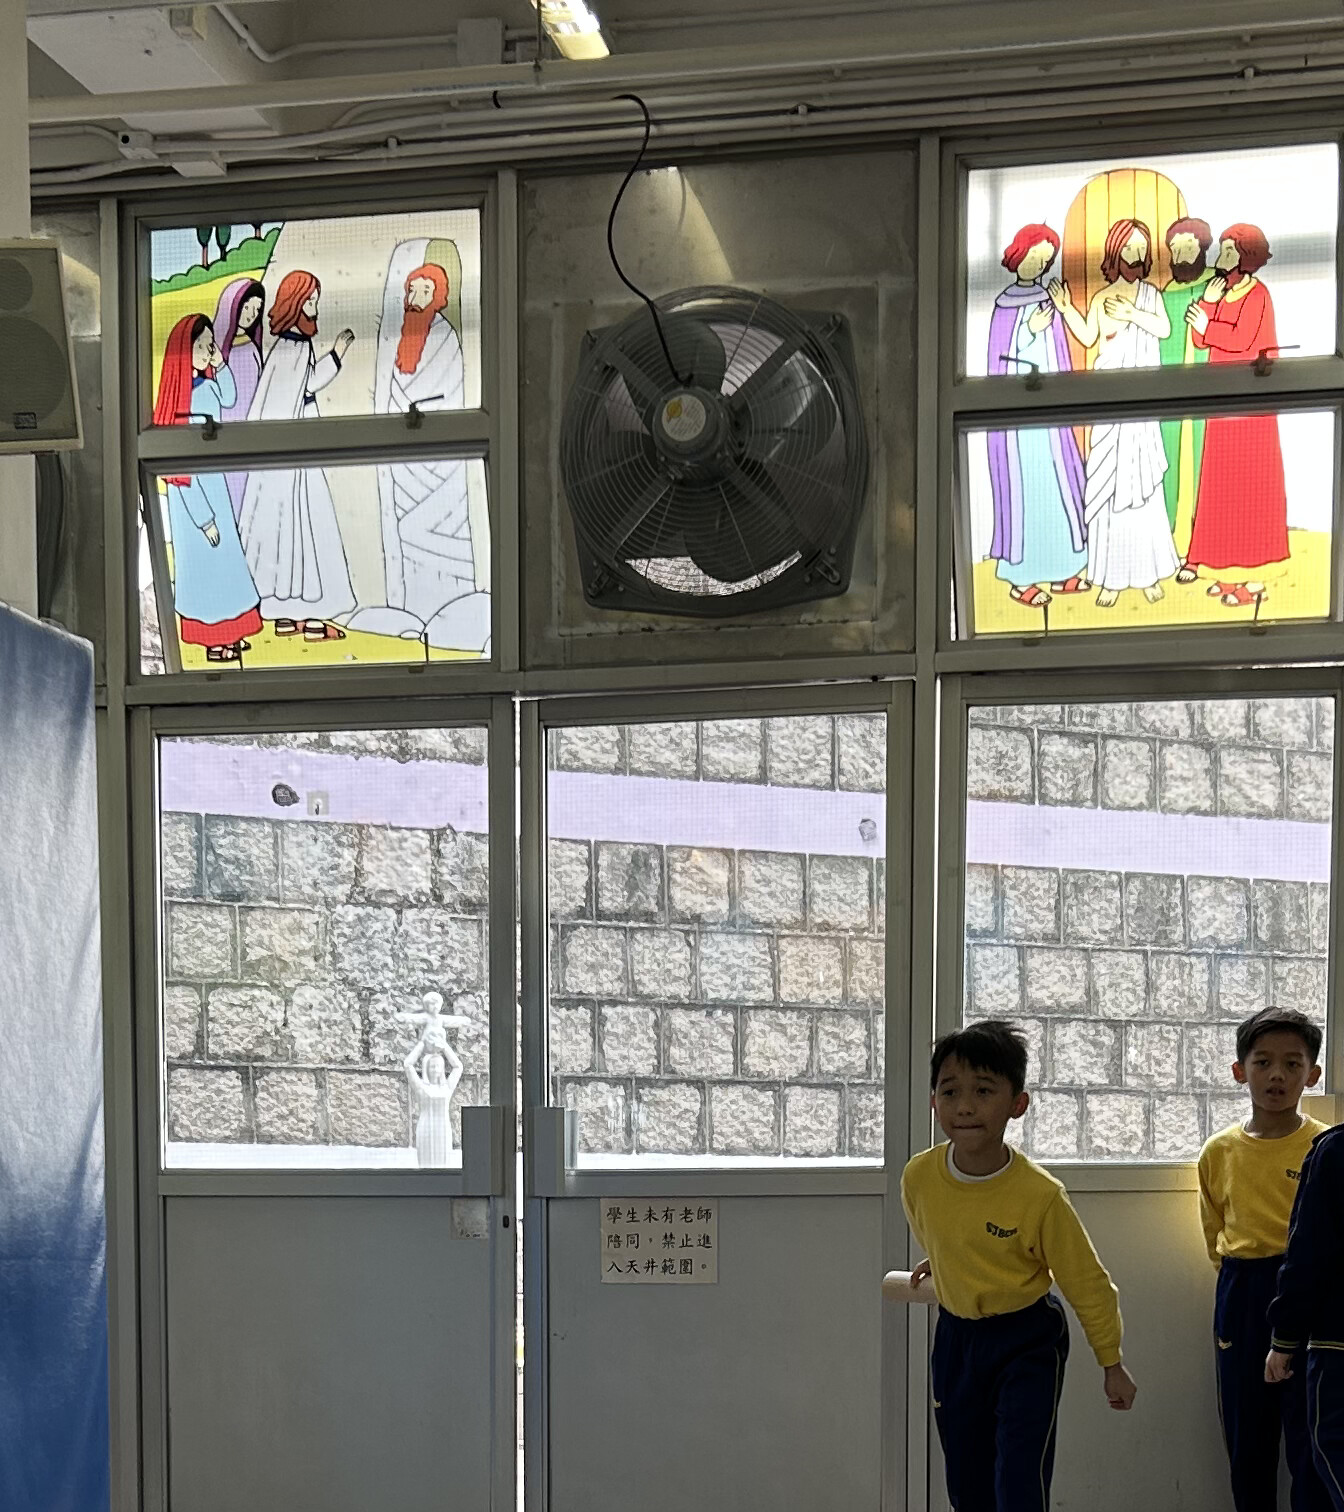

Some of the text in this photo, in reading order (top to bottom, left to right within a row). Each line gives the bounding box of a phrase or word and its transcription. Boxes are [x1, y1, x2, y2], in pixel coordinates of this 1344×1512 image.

[606, 1206, 713, 1224] 學生未有老師
